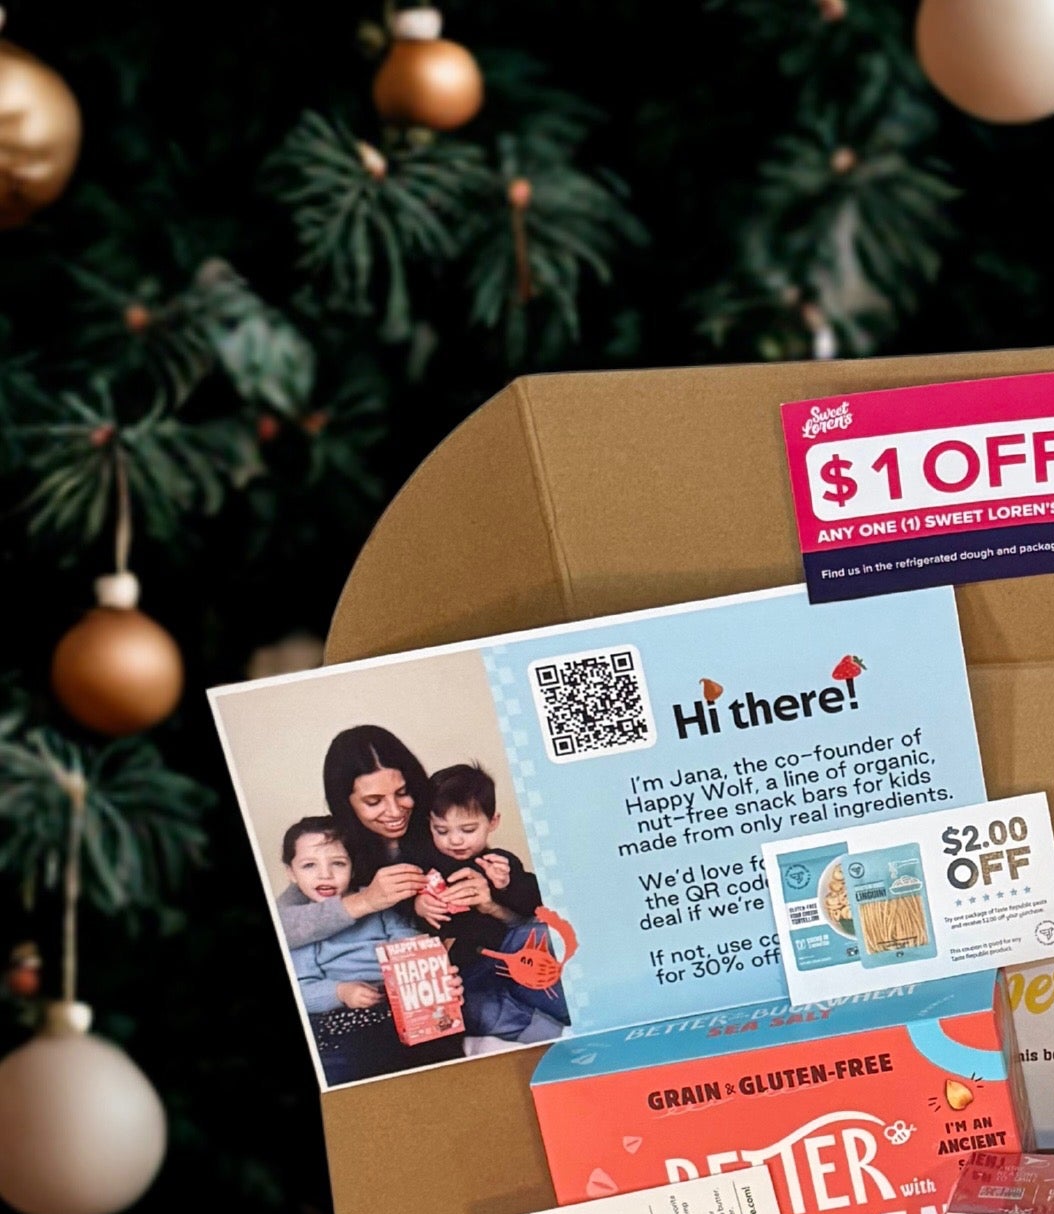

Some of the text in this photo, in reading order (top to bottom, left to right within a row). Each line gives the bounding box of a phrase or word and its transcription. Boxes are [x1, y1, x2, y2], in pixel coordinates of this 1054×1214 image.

[810, 401, 849, 422] Sweet
[817, 525, 854, 543] ANY
[858, 520, 897, 536] ONE
[900, 515, 920, 532] (1)
[924, 509, 983, 528] SWEET
[821, 567, 845, 579] Find
[847, 567, 860, 576] us
[862, 564, 873, 573] in
[874, 561, 893, 571] the
[895, 552, 957, 568] refrigerated
[959, 548, 994, 560] dough
[996, 545, 1016, 555] and
[672, 676, 859, 739] Hi there!
[630, 727, 921, 794] I'm Jana, the co-founder of
[618, 787, 953, 856] made from only real ingredients.
[942, 816, 1028, 856] $2.00
[947, 848, 1031, 890] OFF
[394, 955, 449, 982] HAPPY
[400, 977, 452, 1012] WOLF
[706, 1010, 831, 1038] SEA SALT
[648, 1053, 893, 1110] GRAIN & GLUTEN-FREE
[946, 1116, 993, 1134] I'M AN
[937, 1131, 1007, 1155] ANCIENT
[900, 1177, 937, 1197] with
